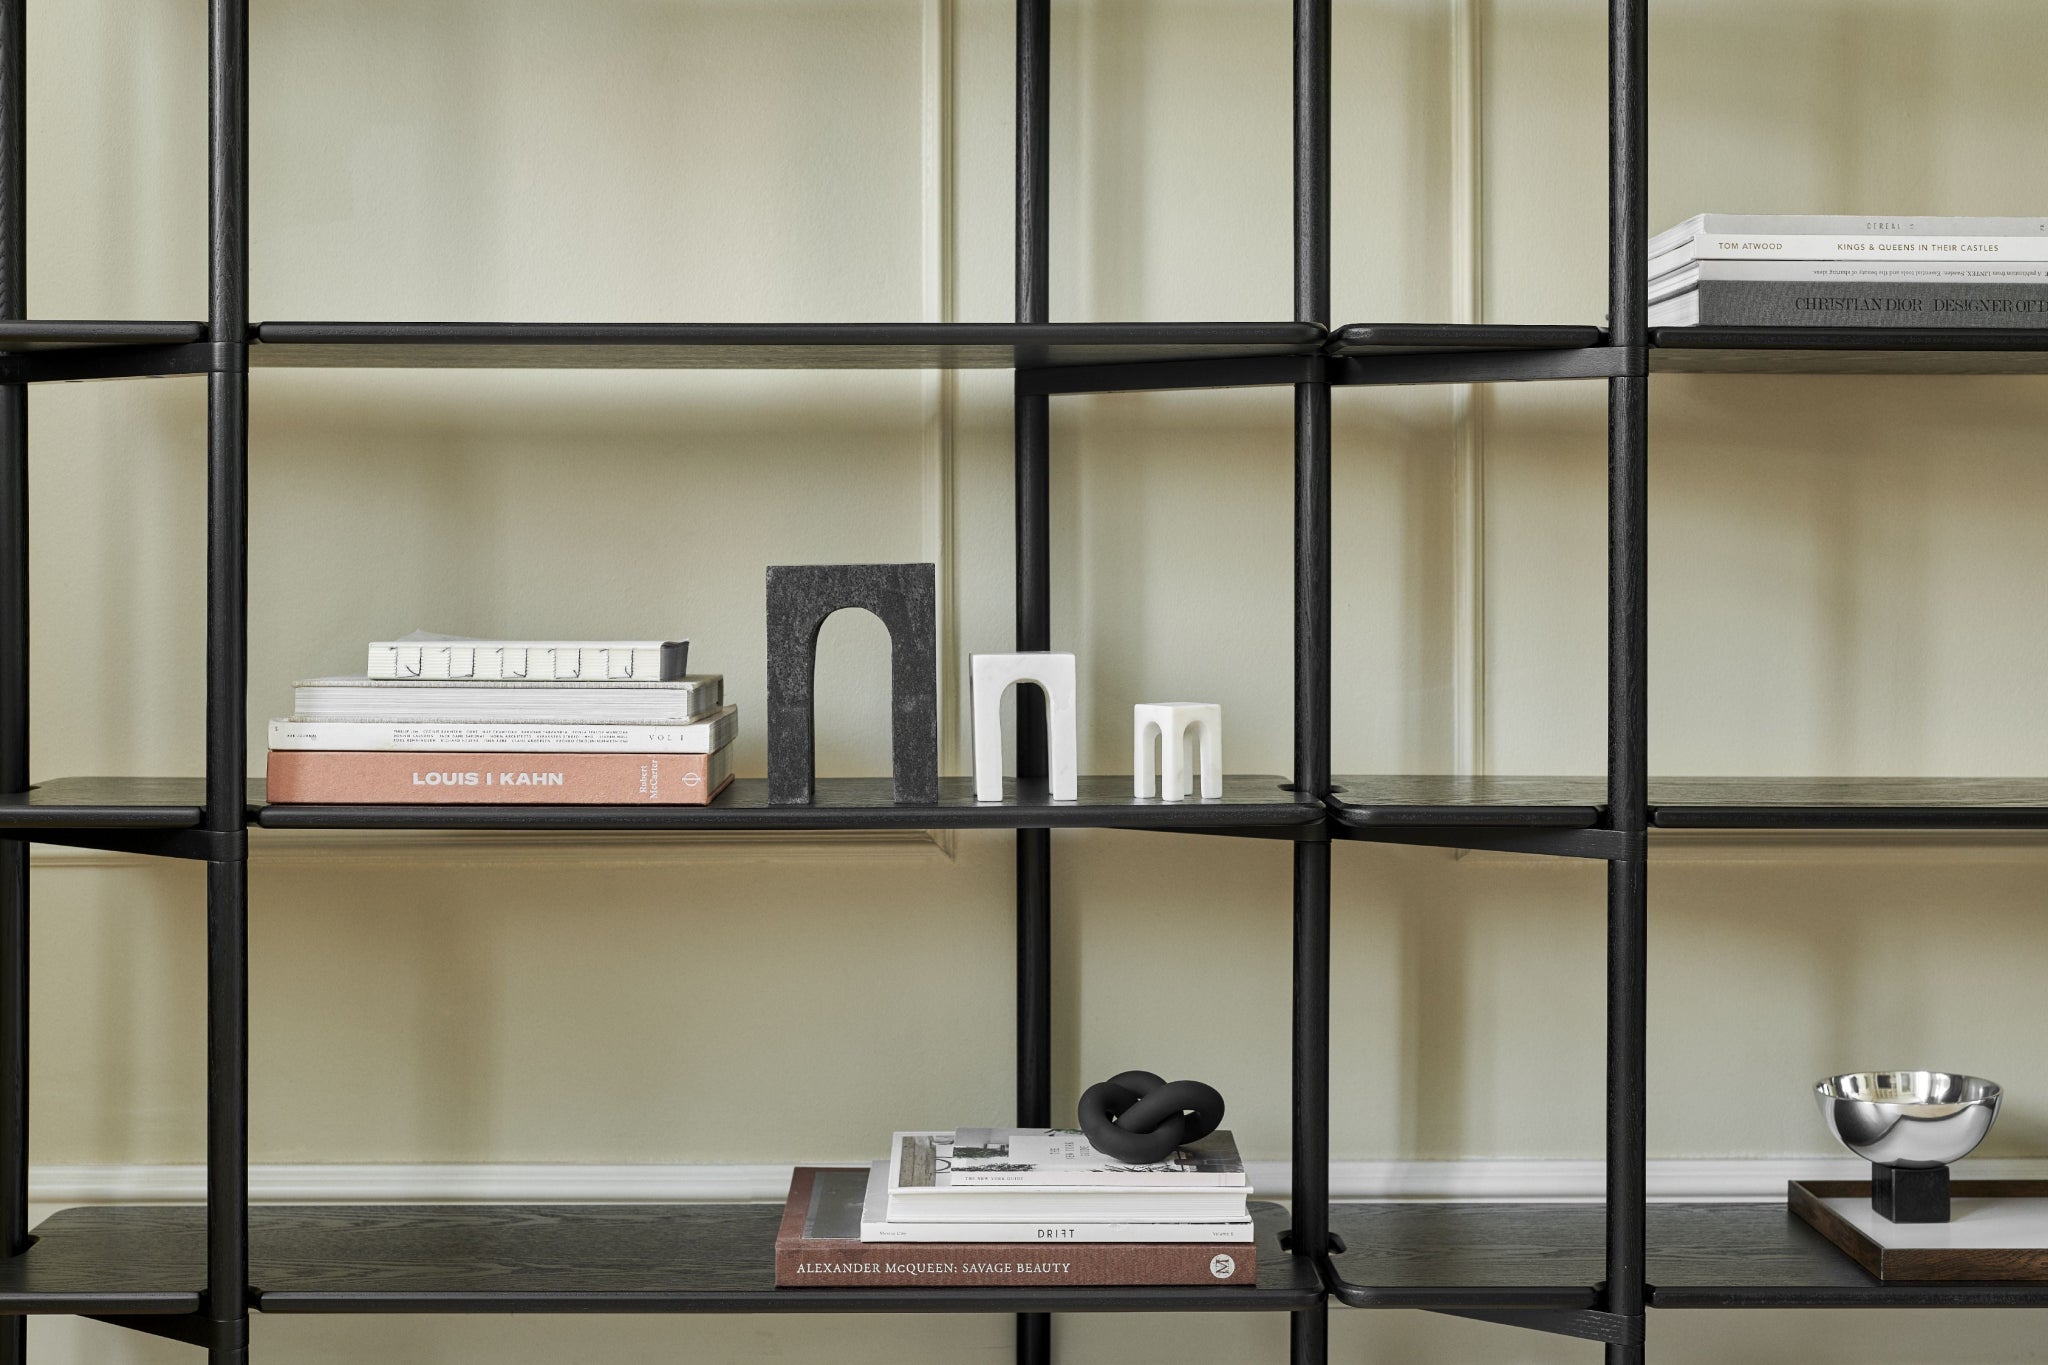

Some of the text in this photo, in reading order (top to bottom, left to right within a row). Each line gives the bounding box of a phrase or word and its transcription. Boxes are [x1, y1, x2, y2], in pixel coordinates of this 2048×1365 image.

[1718, 242, 1739, 250] TOM
[1742, 242, 1783, 250] ATWOOD
[1837, 243, 1866, 251] KINGS
[1868, 243, 1875, 251] &
[1879, 244, 1915, 252] QUEENS
[1932, 244, 1957, 252] THEIR
[1960, 244, 1999, 252] CASTLES
[1795, 297, 1882, 311] CHRISTIAN
[1886, 298, 1923, 312] DIOR
[1934, 299, 2013, 313] DESIGNER
[412, 771, 564, 786] LOUIS I KAHN
[639, 765, 648, 793] Robert
[649, 759, 659, 799] McCarter
[1037, 1229, 1075, 1238] DRIFT
[796, 1262, 1071, 1276] ALEXANDER McQUEEN: SAVAGE BEAUTY
